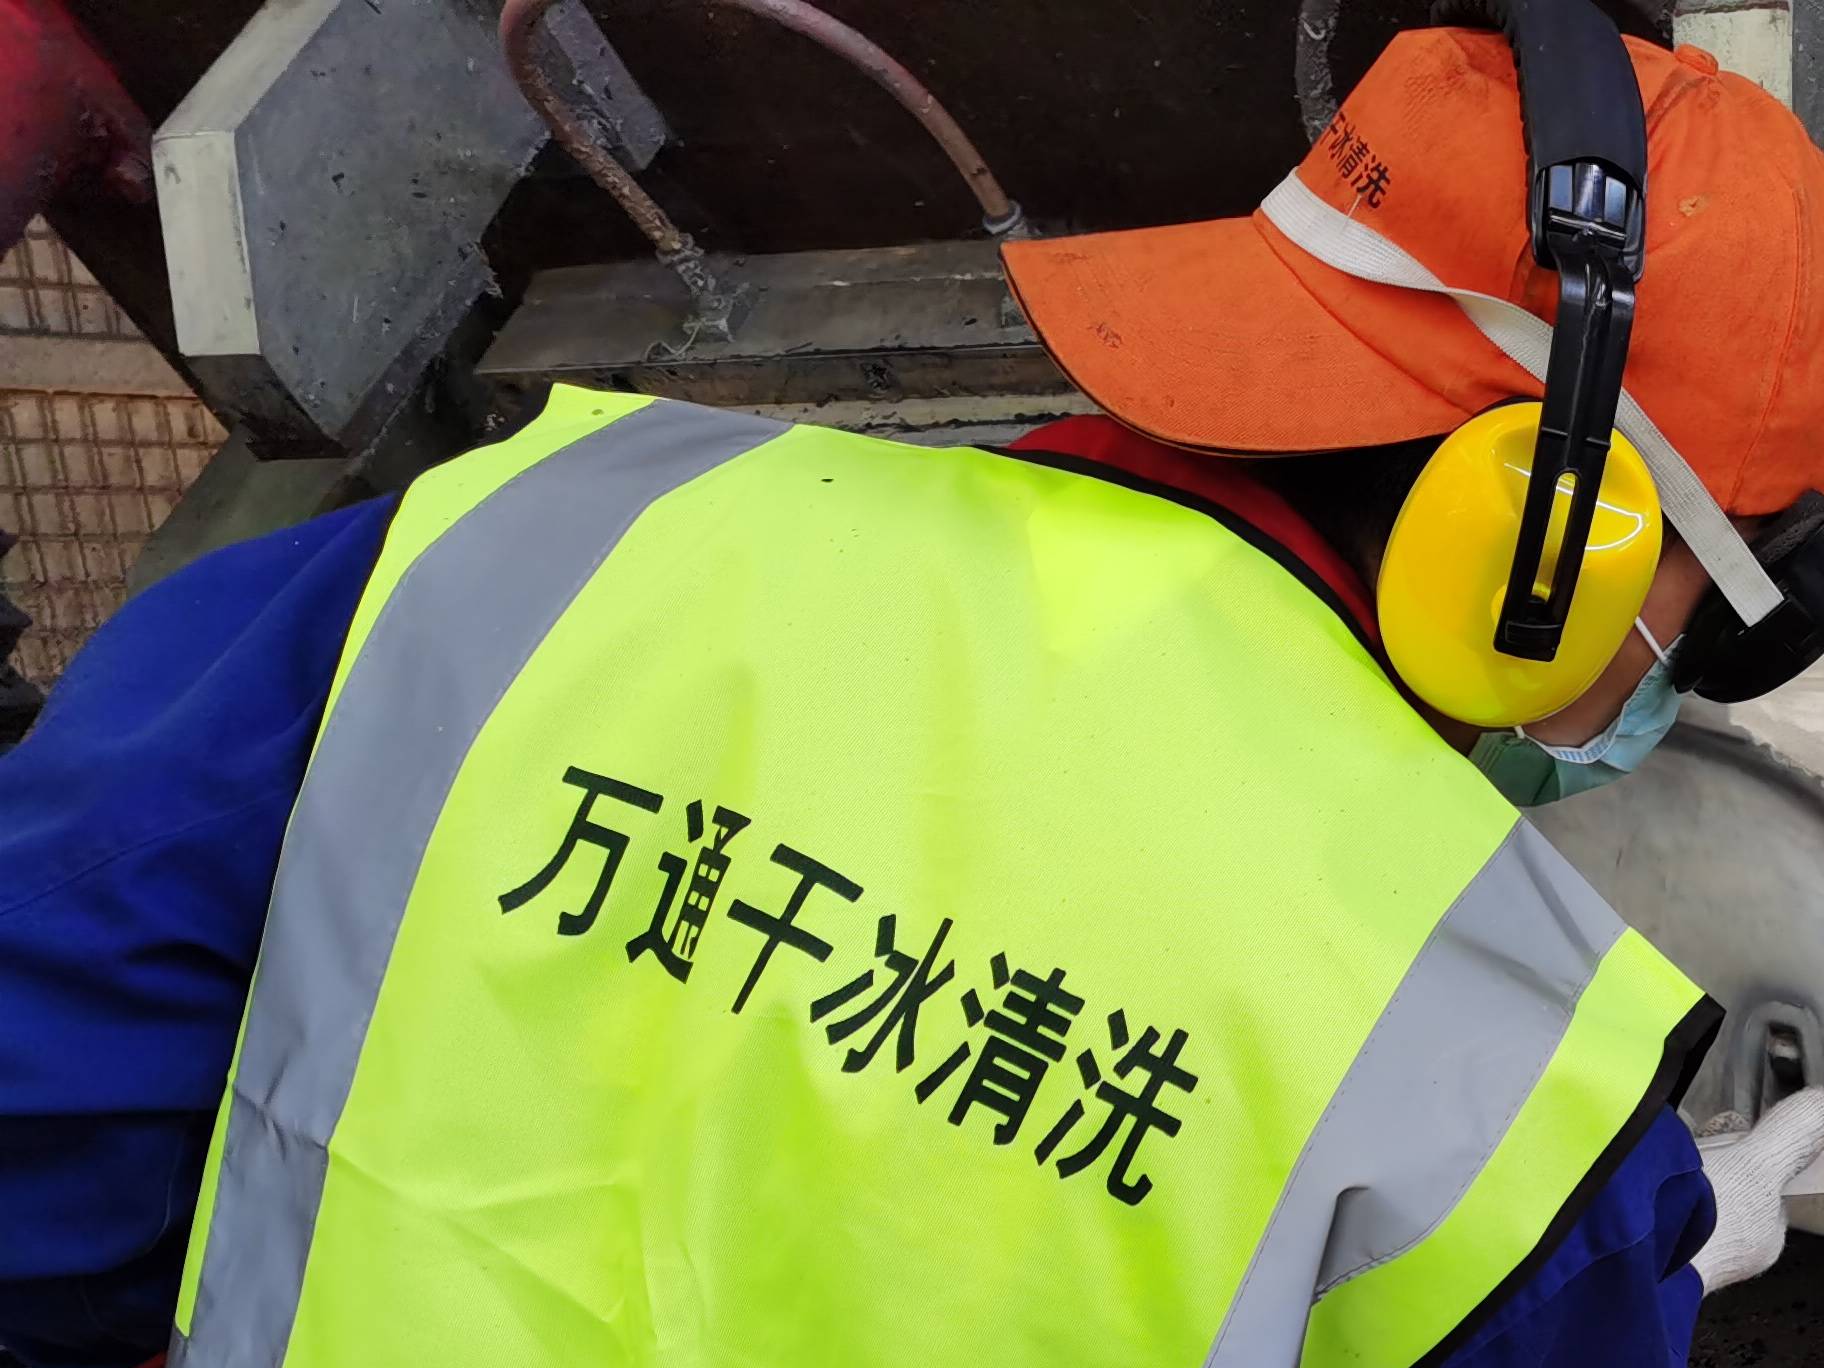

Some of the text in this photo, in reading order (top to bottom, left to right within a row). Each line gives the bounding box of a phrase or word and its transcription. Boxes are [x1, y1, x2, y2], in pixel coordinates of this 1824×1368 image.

[498, 766, 1198, 1205] 万通干冰清洗
